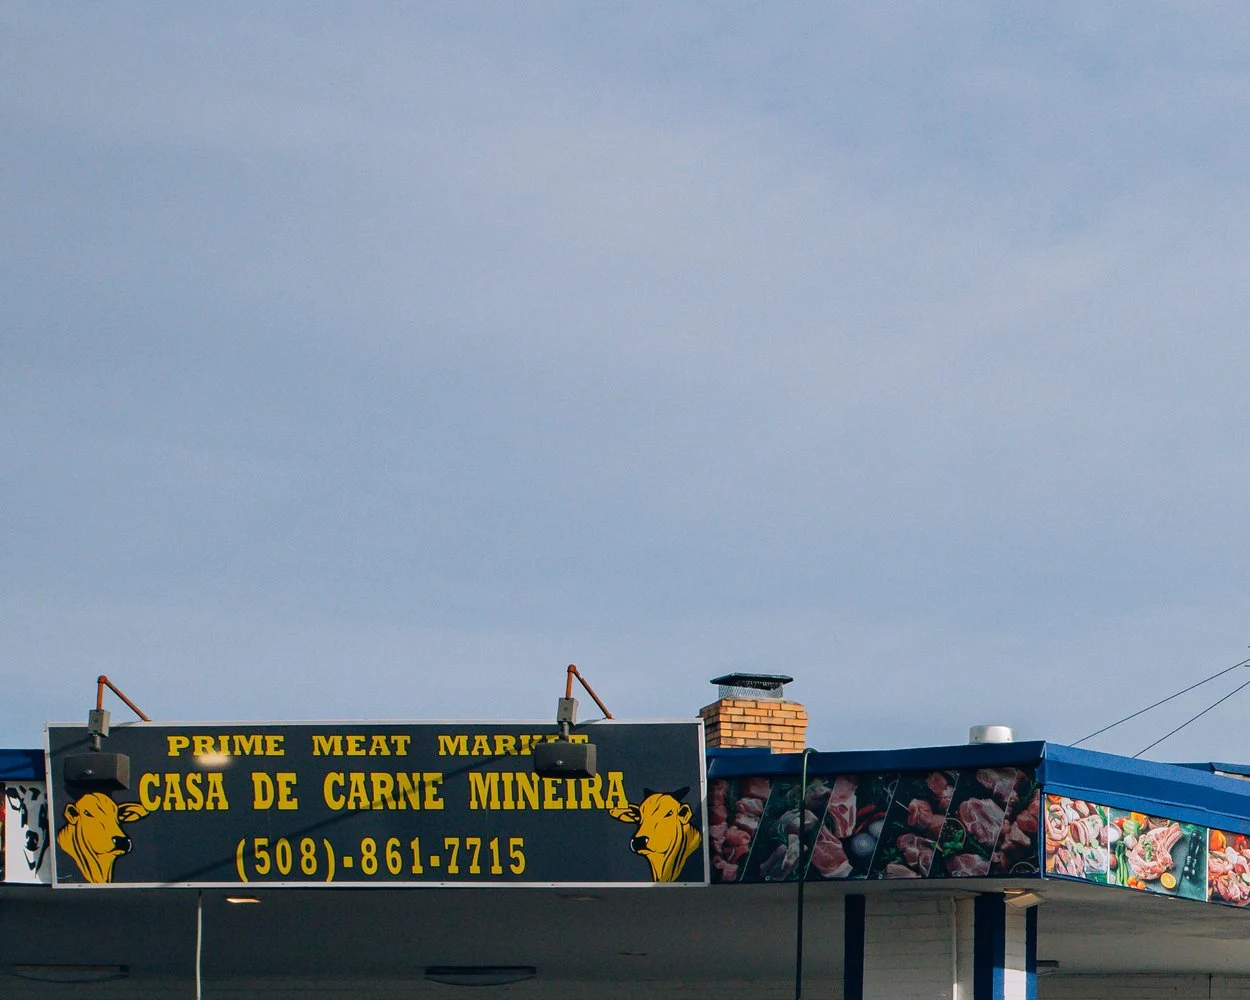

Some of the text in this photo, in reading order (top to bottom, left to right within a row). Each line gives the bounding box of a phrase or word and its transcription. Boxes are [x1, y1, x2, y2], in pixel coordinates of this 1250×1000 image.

[166, 734, 589, 757] PRIME MEAT MARKT
[139, 772, 629, 811] CASA DE CARNE MINEIRA
[236, 837, 526, 882] (508)-861-7715
